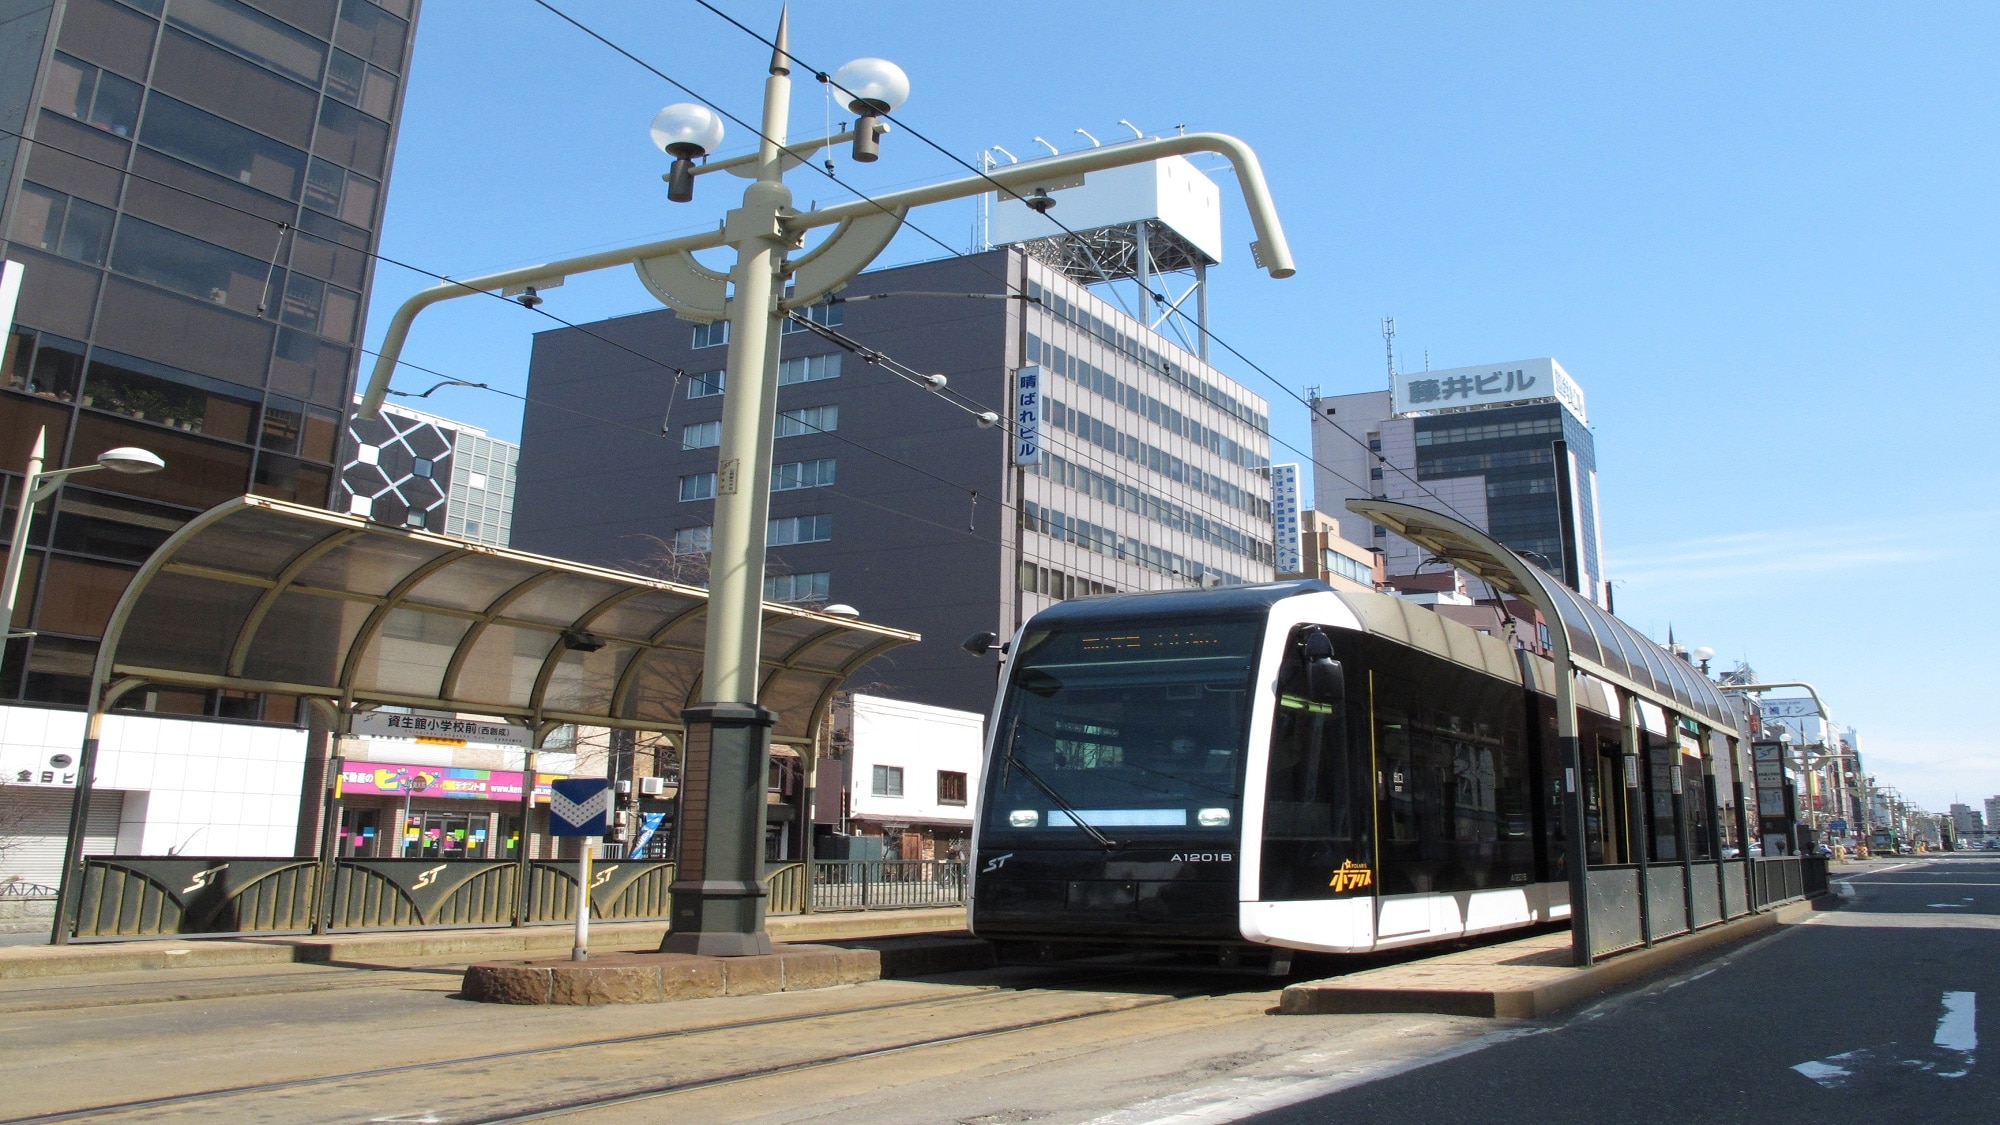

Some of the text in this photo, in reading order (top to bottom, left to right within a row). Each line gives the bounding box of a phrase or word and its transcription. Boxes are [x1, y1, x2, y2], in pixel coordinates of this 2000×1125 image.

[1408, 369, 1536, 404] 藤井ビル
[1019, 375, 1036, 456] 晴ばれビル
[411, 864, 447, 890] ST
[982, 853, 1014, 873] ST
